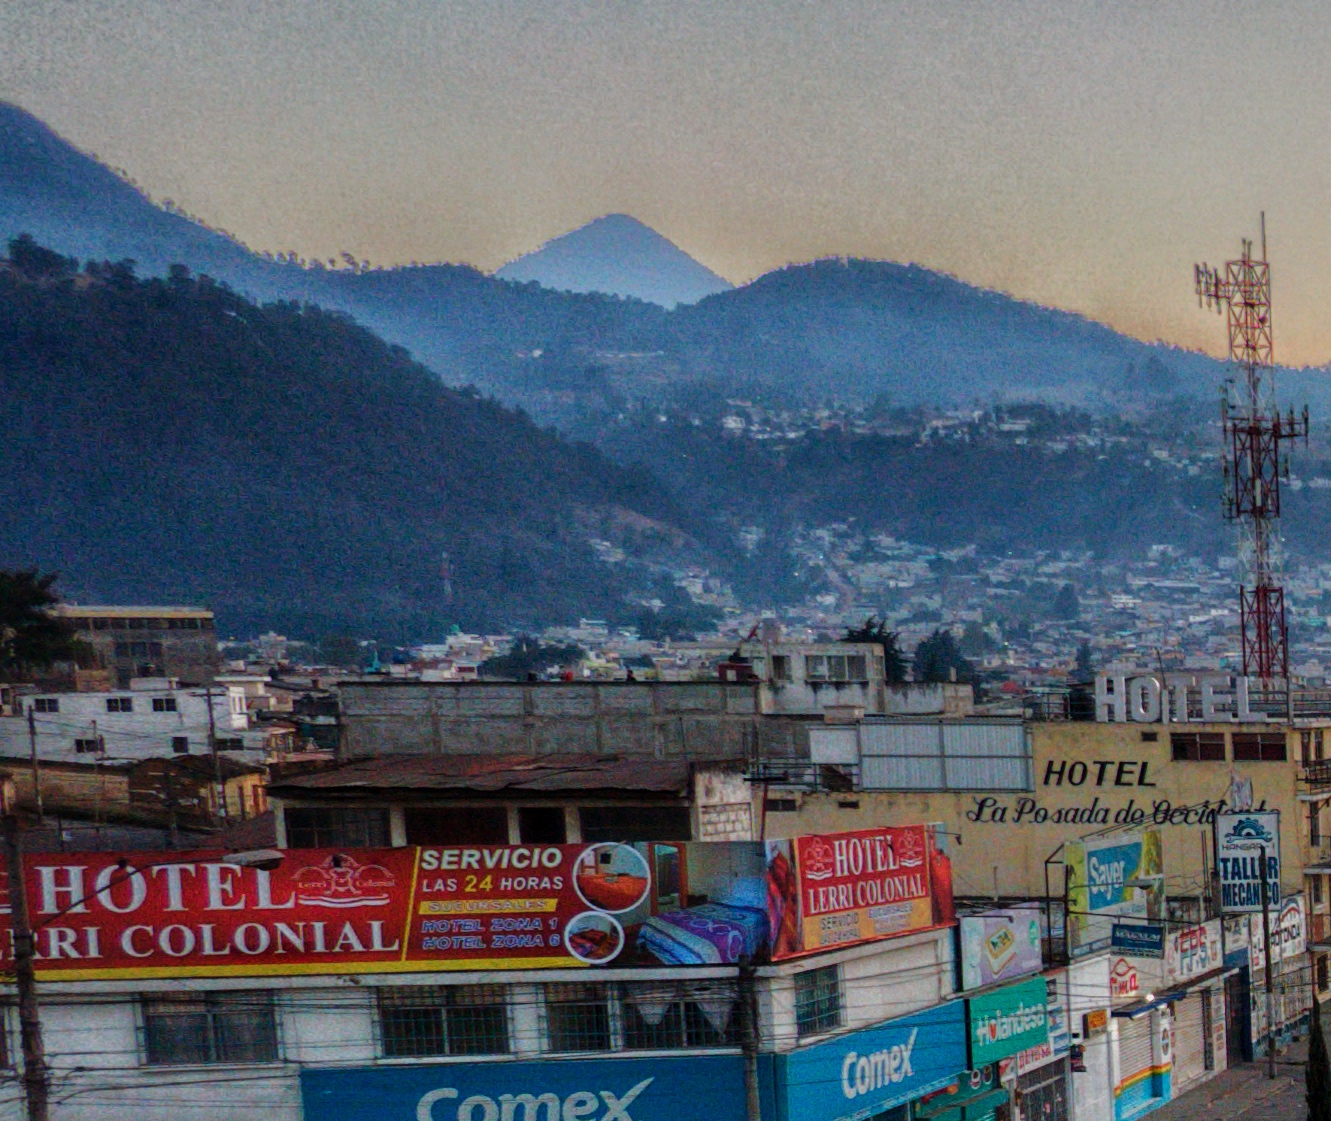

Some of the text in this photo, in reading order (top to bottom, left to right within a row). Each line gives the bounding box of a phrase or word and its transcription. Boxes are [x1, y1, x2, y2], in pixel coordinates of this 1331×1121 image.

[1095, 676, 1267, 723] HOTEL
[1042, 760, 1157, 787] HOTEL
[966, 797, 1007, 824] La
[1012, 796, 1110, 824] Posada
[1114, 798, 1146, 825] de
[421, 846, 563, 870] SERVICIO
[833, 834, 900, 878] HOTEL
[1220, 856, 1278, 881] TALLR
[34, 862, 296, 914] HOTEL
[422, 874, 564, 893] LAS 24 HORAS
[1089, 856, 1126, 901] Sayer
[428, 899, 548, 913] SUCURSALES
[808, 873, 927, 915] LERRI COLONIAL
[121, 920, 400, 958] COLONIAL
[421, 917, 559, 934] HOTEL ZONA 1
[422, 932, 561, 951] HOTEL ZONA 6
[842, 1026, 919, 1100] Comex
